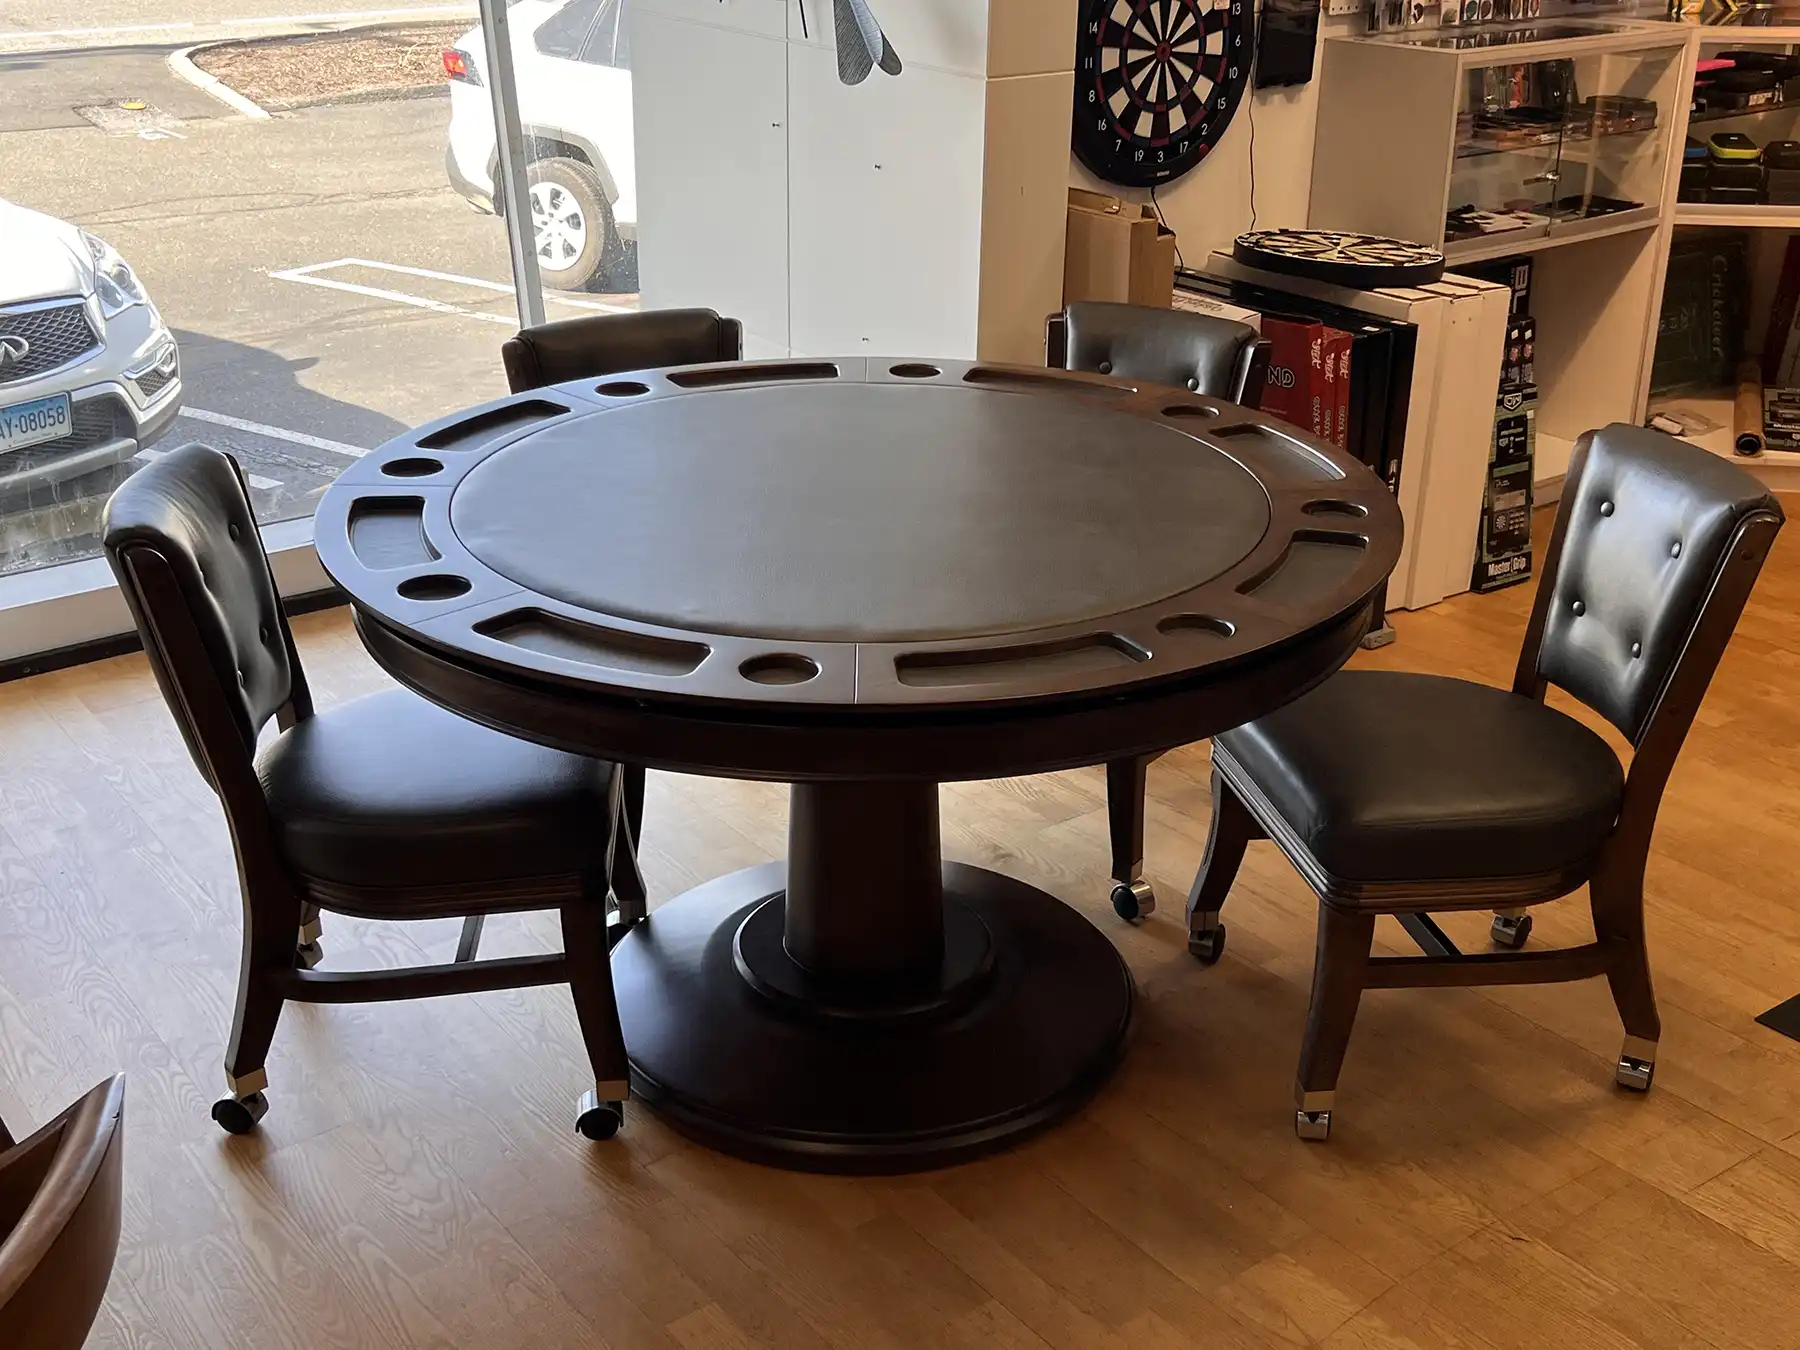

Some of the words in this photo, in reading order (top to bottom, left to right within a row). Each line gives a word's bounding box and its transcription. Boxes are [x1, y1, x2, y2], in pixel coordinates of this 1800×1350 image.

[1232, 3, 1241, 15] 13
[1089, 22, 1098, 34] 14
[1235, 34, 1241, 47] 6
[1085, 57, 1093, 69] 11
[1229, 67, 1238, 79] 10
[1088, 90, 1096, 102] 8
[1217, 98, 1226, 110] 15
[1098, 119, 1107, 131] 16
[1201, 124, 1208, 136] 2
[1115, 140, 1122, 152] 7
[1179, 142, 1189, 154] 17
[1134, 150, 1144, 162] 19
[1157, 151, 1164, 163] 3
[1513, 556, 1527, 571] Grip
